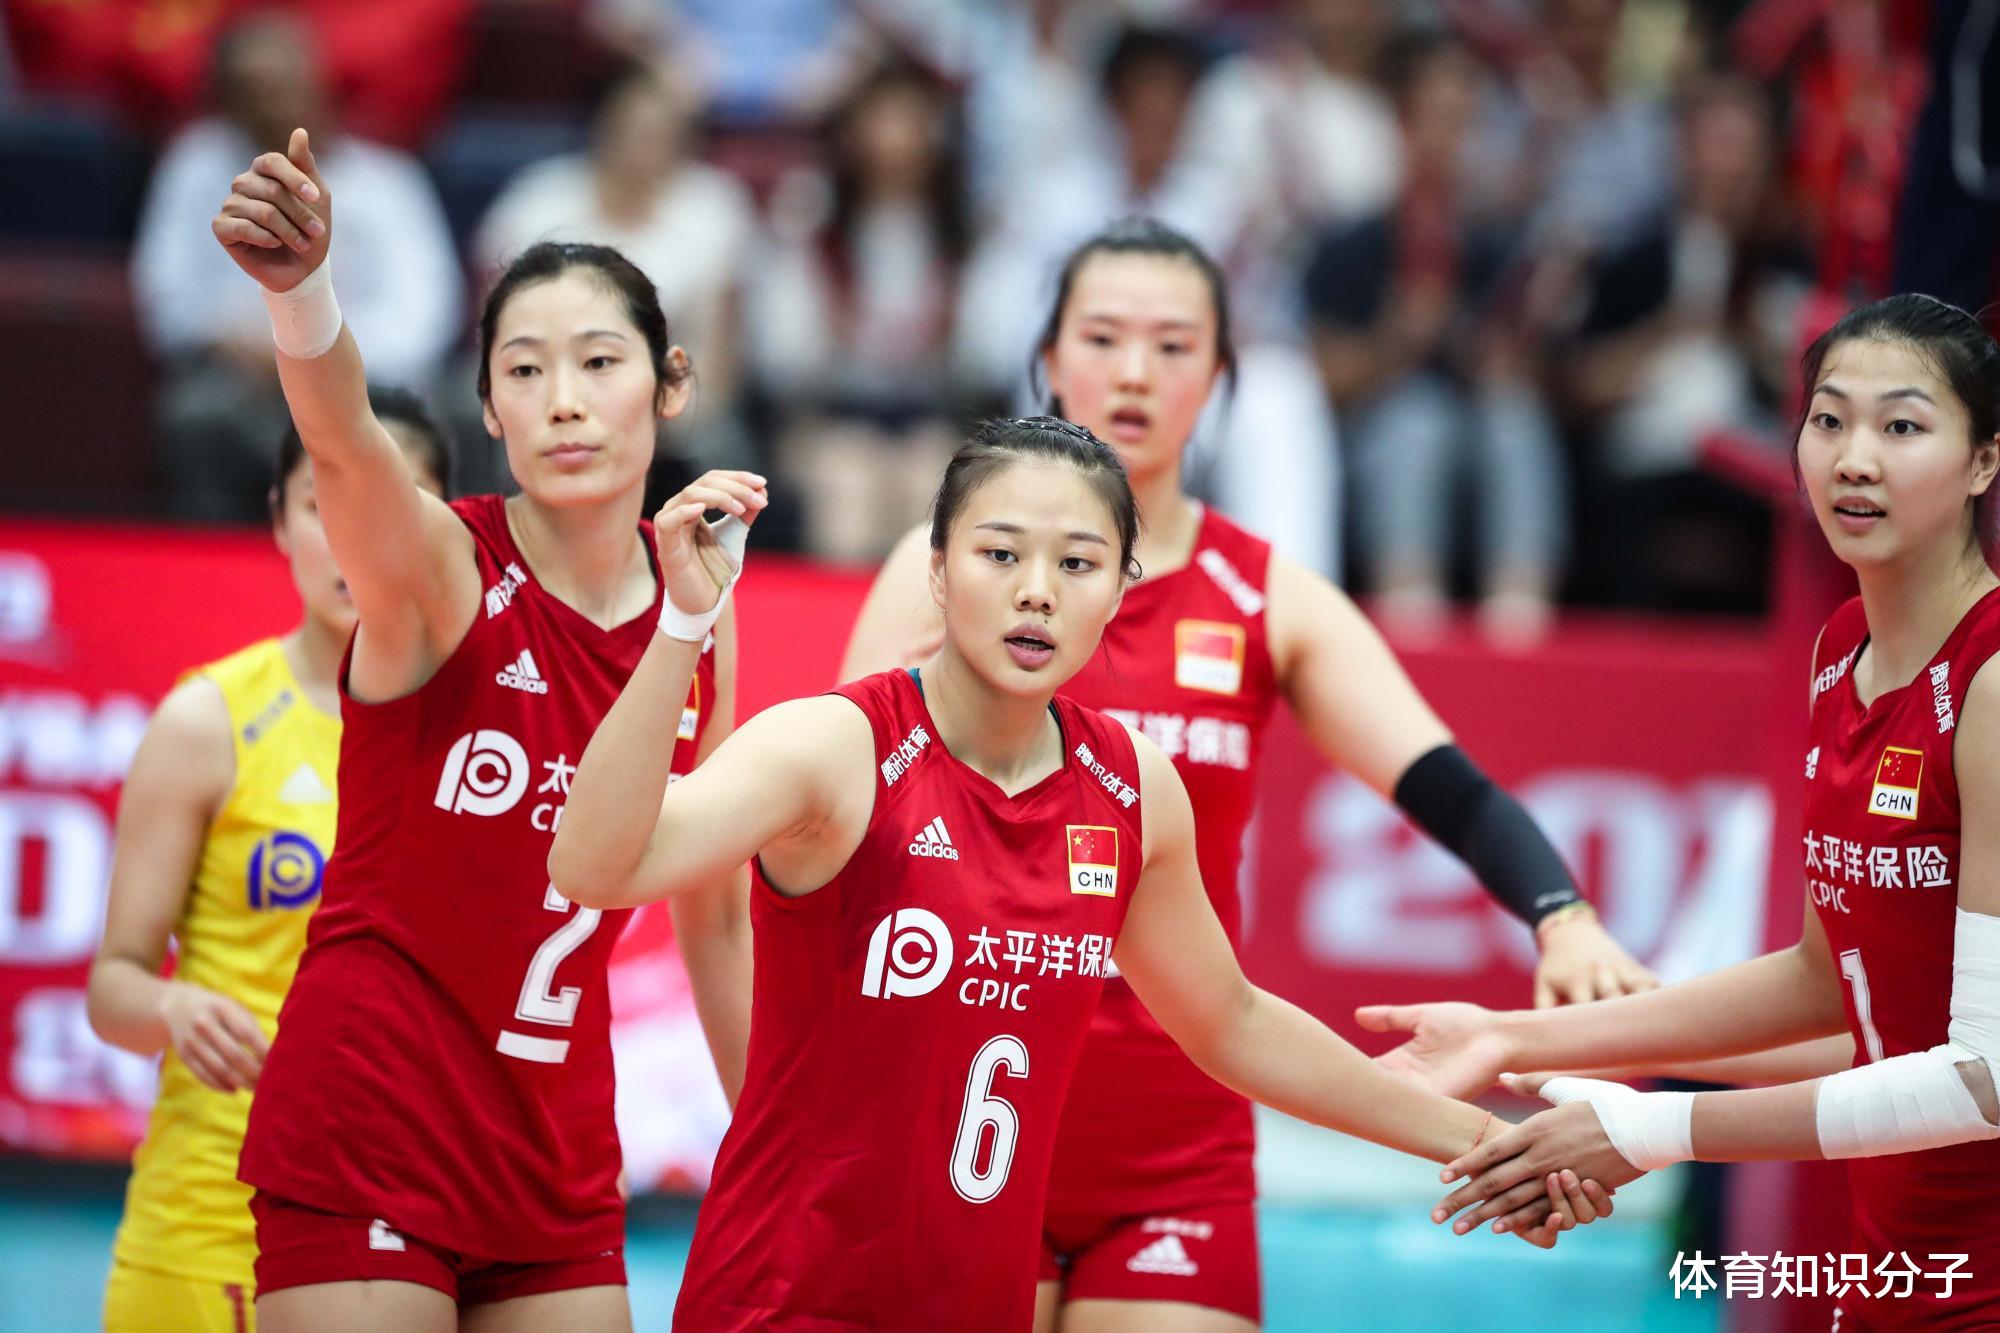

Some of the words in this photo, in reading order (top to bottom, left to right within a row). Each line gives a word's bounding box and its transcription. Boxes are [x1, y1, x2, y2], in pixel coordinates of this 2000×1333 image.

[880, 724, 931, 787] 腾讯体育
[1074, 742, 1140, 808] 腾讯体育
[1875, 791, 1913, 812] CHN
[908, 839, 959, 861] adidas
[1802, 829, 1952, 889] 太平洋保险
[1077, 871, 1114, 889] CHN
[1809, 879, 1850, 914] CPIC
[514, 881, 603, 1027] 2
[959, 977, 1031, 1012] CPIC
[949, 1034, 1030, 1204] 6
